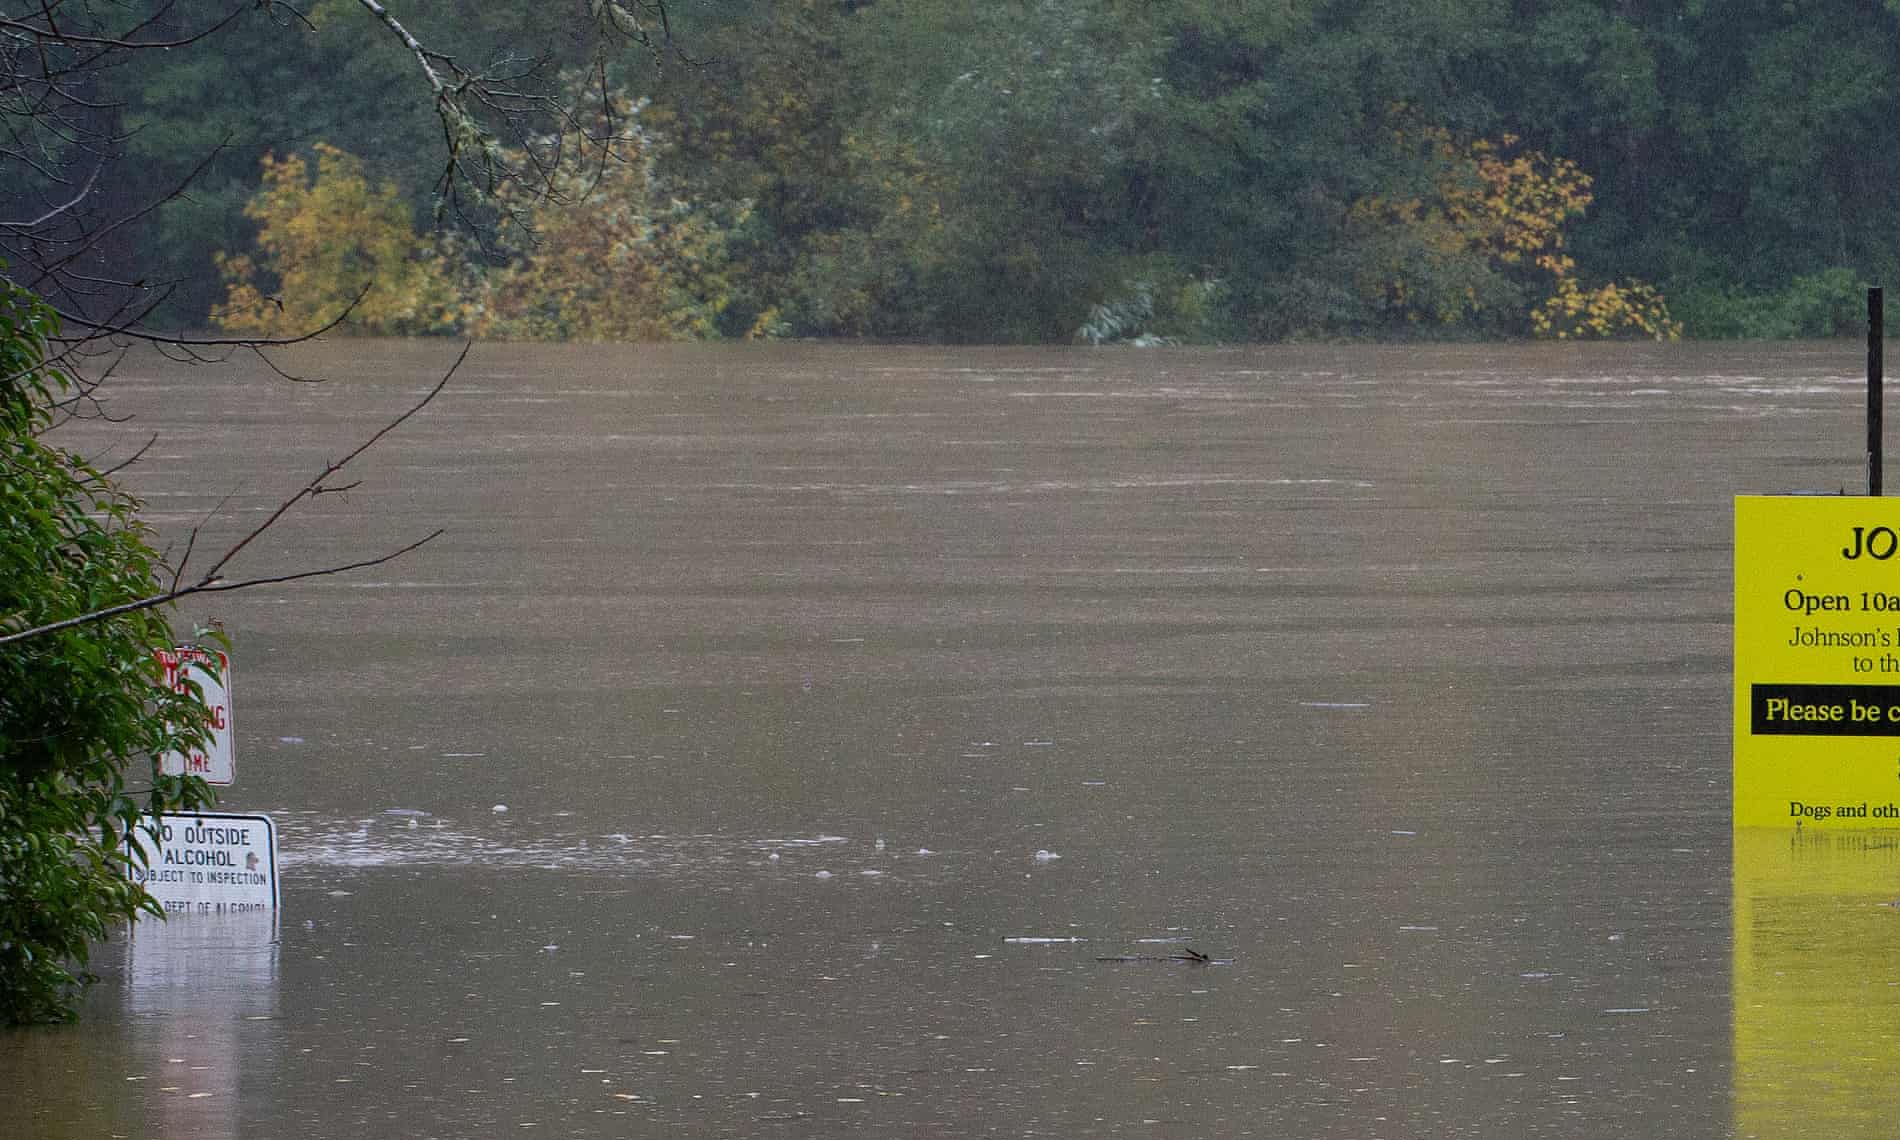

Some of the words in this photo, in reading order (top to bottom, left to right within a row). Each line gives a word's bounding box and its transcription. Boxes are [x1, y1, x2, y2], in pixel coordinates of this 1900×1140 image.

[1784, 589, 1850, 616] Open
[1788, 627, 1891, 647] Johnson's
[1853, 657, 1873, 673] to
[1766, 698, 1843, 721] Please
[1850, 700, 1881, 721] be
[1790, 802, 1831, 820] Dogs
[1836, 802, 1867, 818] and
[185, 827, 251, 846] OUTSIDE
[165, 850, 238, 867] ALCOHOL
[190, 872, 204, 884] TO
[207, 872, 266, 885] INSPECTION
